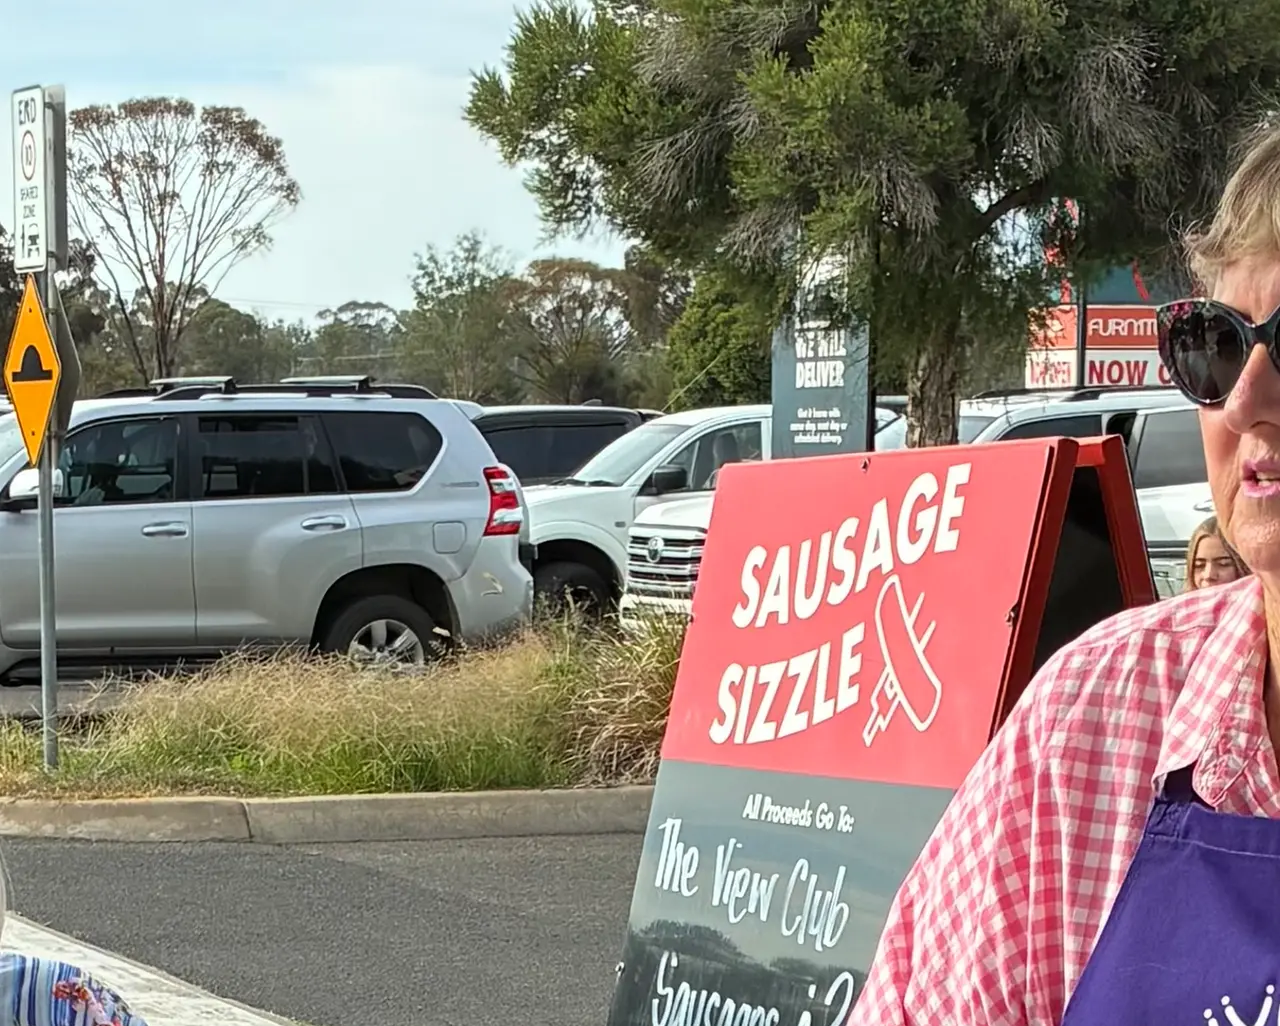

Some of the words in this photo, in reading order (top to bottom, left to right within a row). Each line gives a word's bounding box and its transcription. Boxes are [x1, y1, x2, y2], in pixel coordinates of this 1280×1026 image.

[795, 360, 845, 389] DELIVER
[1087, 360, 1148, 386] NOW
[731, 463, 972, 629] SAUSAGE
[708, 621, 866, 746] SIZZLE
[742, 793, 762, 820] All
[761, 796, 813, 828] Proceeds
[815, 802, 834, 830] Go
[837, 805, 855, 833] To:
[654, 818, 699, 897] The
[712, 838, 779, 924] View
[781, 858, 850, 951] Club
